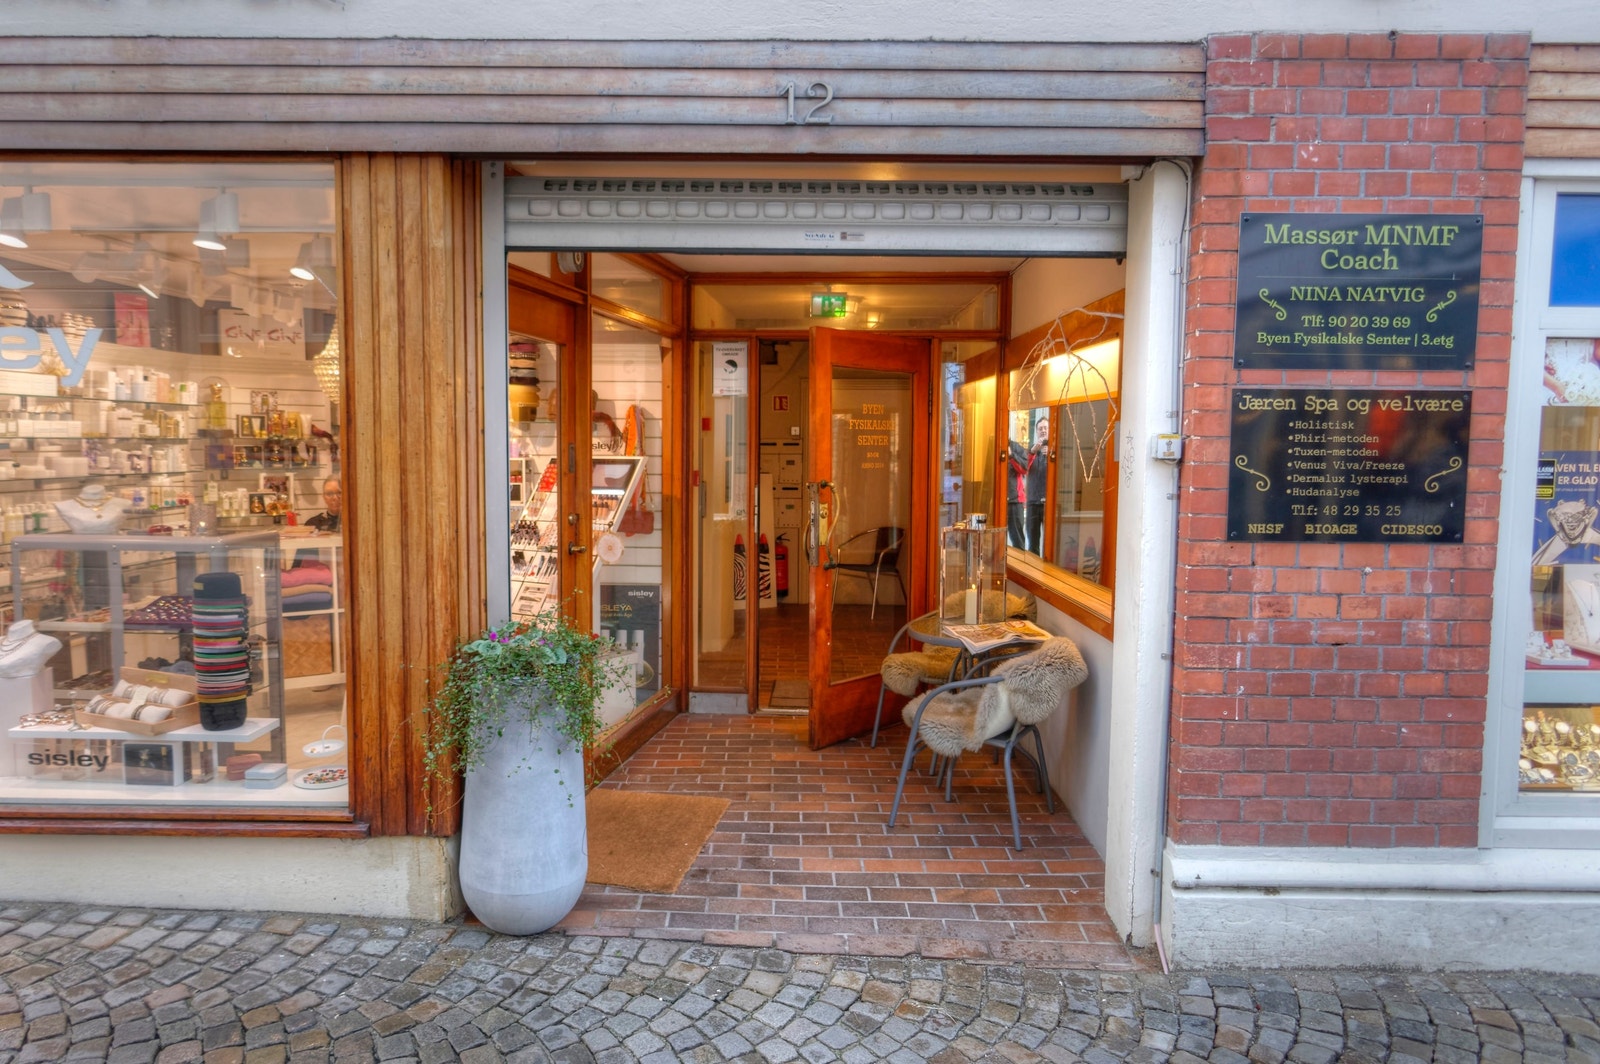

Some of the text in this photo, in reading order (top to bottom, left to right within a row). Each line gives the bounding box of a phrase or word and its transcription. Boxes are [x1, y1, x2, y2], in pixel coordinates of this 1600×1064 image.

[779, 81, 834, 125] 12
[1264, 223, 1459, 246] Massør MNMF
[1320, 248, 1399, 270] Coach
[1290, 286, 1426, 303] NINA NATVIG
[1301, 314, 1411, 328] Tlf: 90 20 39 69
[1256, 332, 1290, 347] Byen
[1293, 332, 1363, 347] Fysikalske
[1366, 333, 1411, 346] Senter
[1421, 334, 1454, 349] 3.etg
[862, 403, 885, 415] BYEN
[1238, 395, 1464, 415] Jæren Spa og velvære
[1295, 420, 1354, 430] Holistisk
[857, 435, 889, 446] SENTER
[1294, 434, 1379, 443] Phiri-metoden
[1293, 447, 1379, 457] Tuxen-metoden
[1294, 461, 1405, 471] Venus Viva/Freeze
[1578, 464, 1591, 472] TIL
[1292, 474, 1409, 485] Dermalux lysterapi
[1558, 476, 1570, 485] ER
[1572, 476, 1598, 485] GLAD
[1292, 487, 1360, 498] Hudanalyse
[1291, 504, 1401, 516] Tlf: 48 29 35 25
[1247, 523, 1443, 535] NHSF BIOAGE CIDESCO
[628, 590, 654, 598] sisley
[27, 749, 109, 773] sisley
